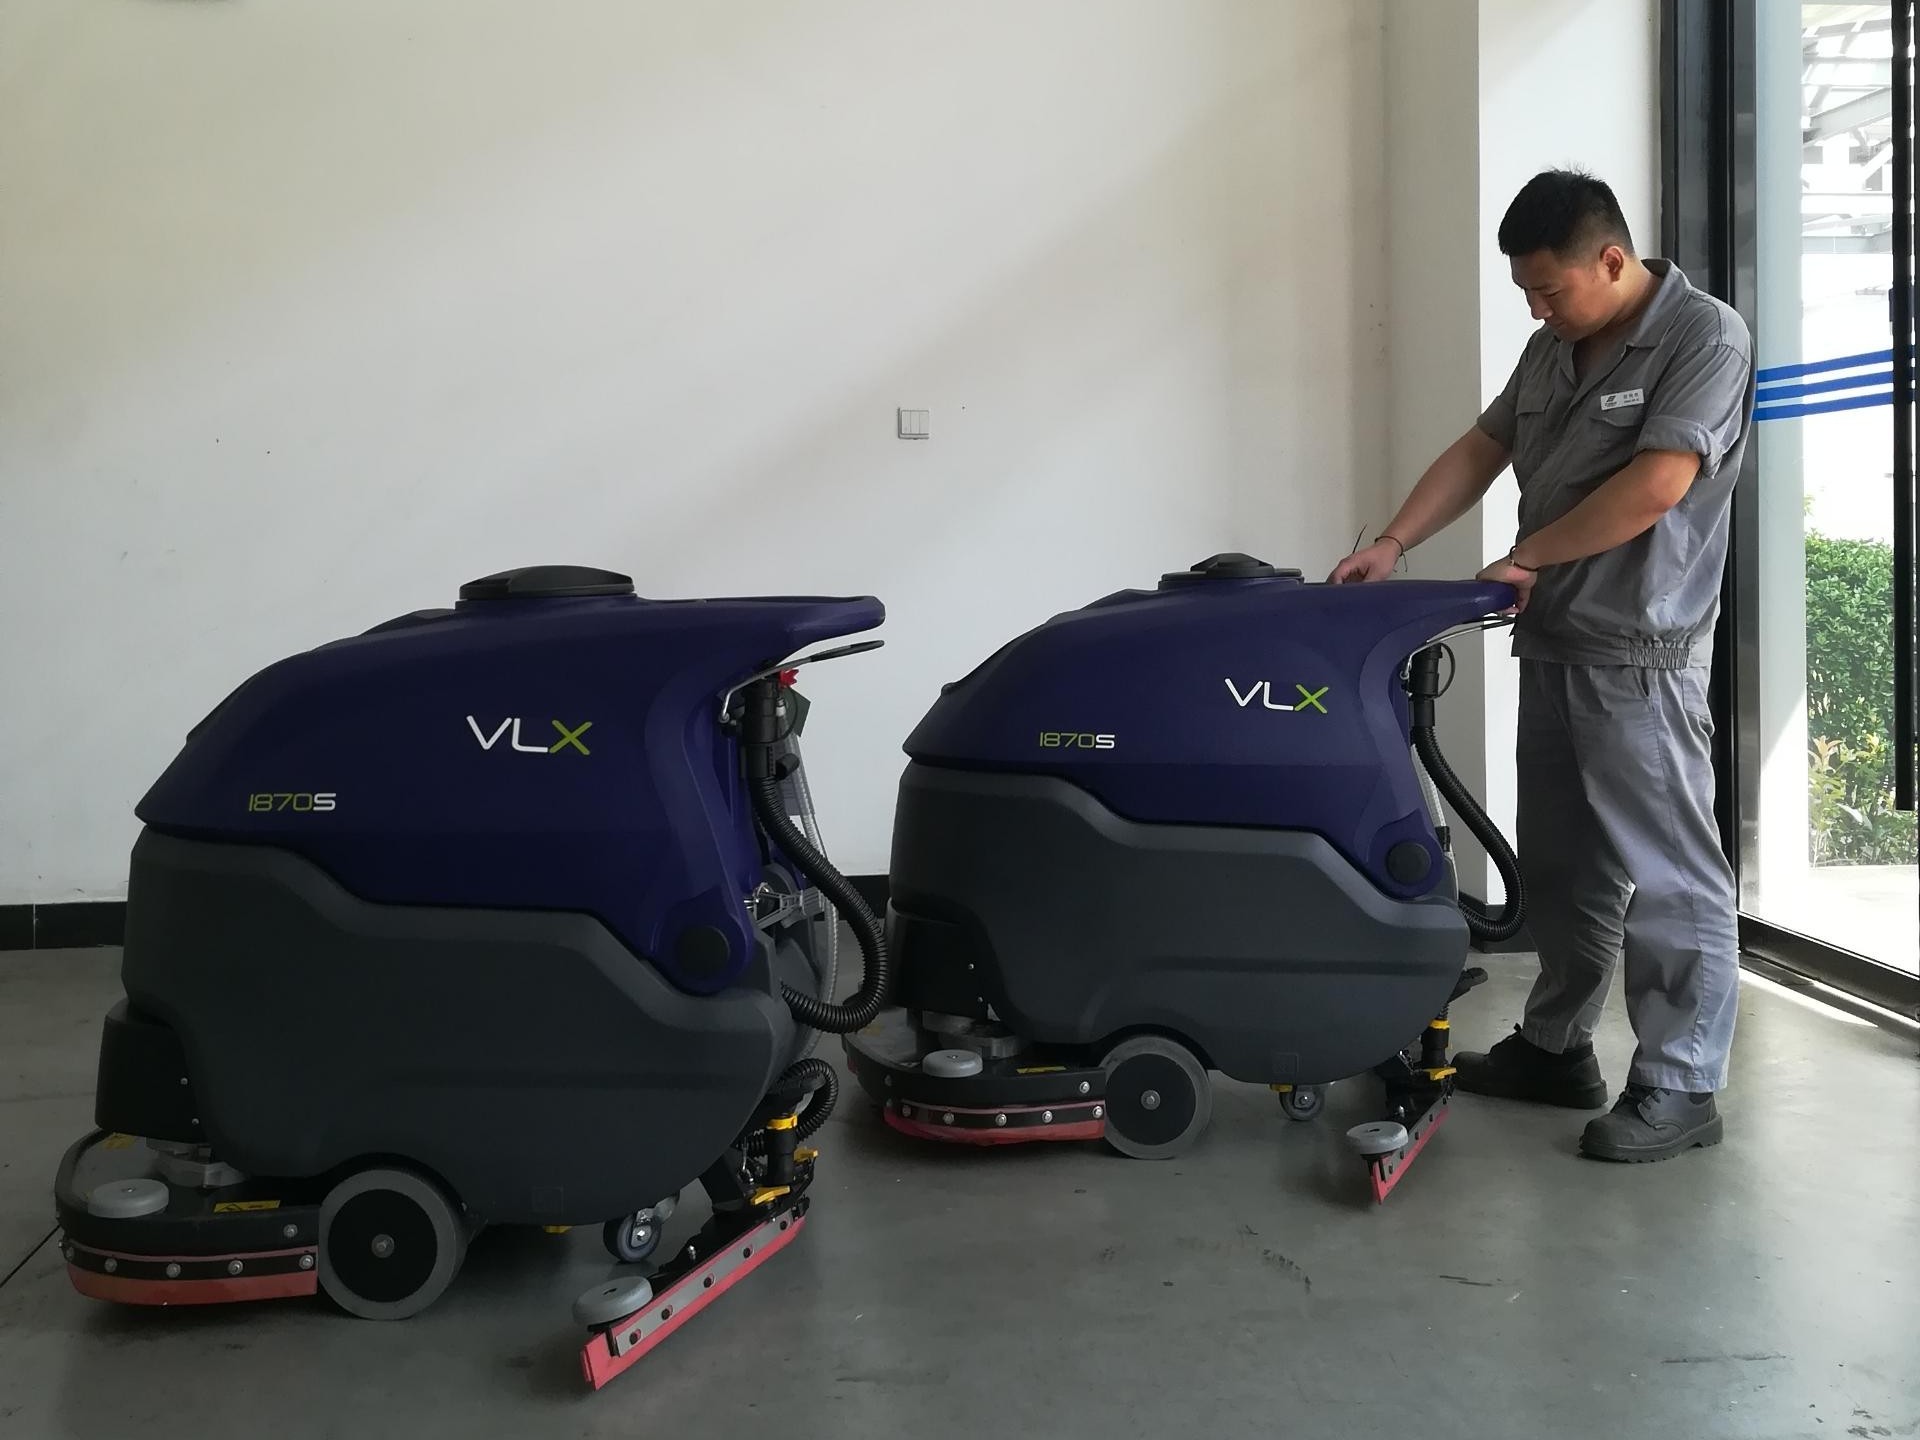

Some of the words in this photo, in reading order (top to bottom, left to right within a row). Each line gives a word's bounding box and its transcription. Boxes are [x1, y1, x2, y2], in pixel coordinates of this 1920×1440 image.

[1224, 678, 1329, 714] VLX
[466, 715, 593, 756] VLX
[1039, 732, 1115, 749] 1870S
[248, 793, 337, 812] 1870S
